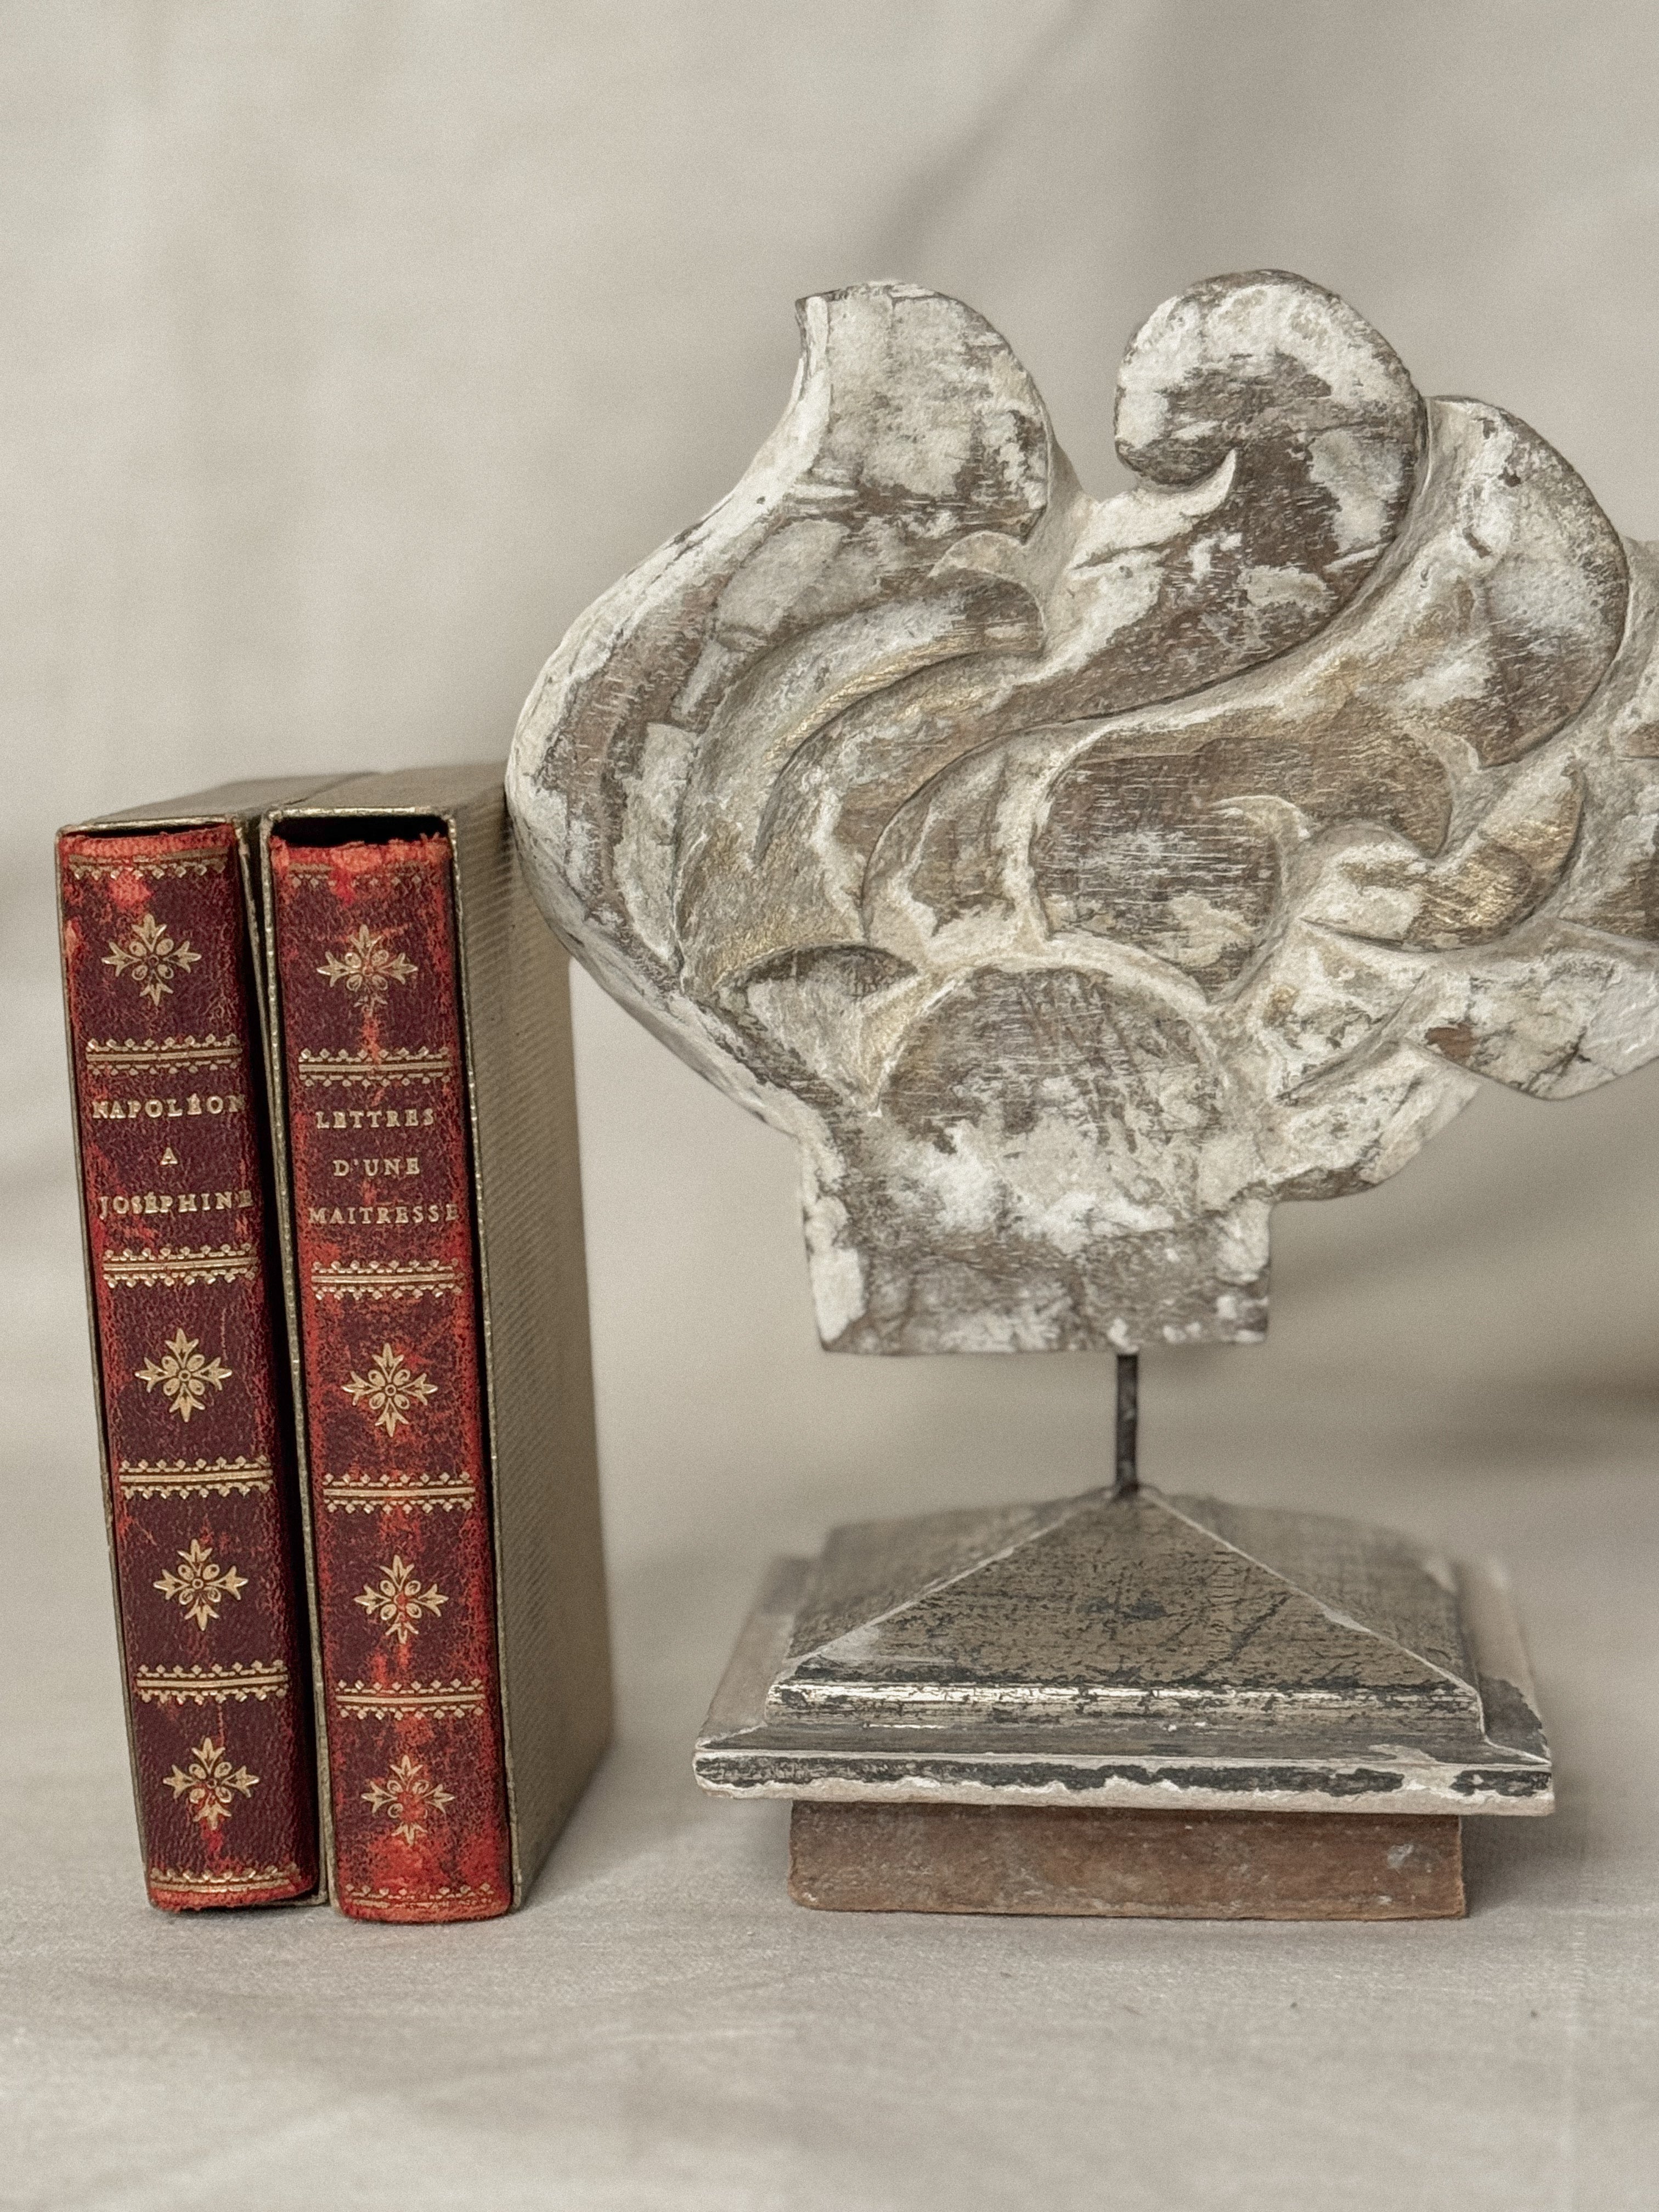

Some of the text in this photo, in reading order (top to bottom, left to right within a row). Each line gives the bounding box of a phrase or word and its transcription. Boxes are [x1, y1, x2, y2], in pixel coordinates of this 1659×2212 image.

[315, 1108, 434, 1129] LETTRES
[159, 1147, 178, 1165] A
[332, 1158, 420, 1176] D'UNE
[98, 1190, 253, 1220] JOSÉPHINE
[308, 1204, 459, 1224] MAITRESSE
